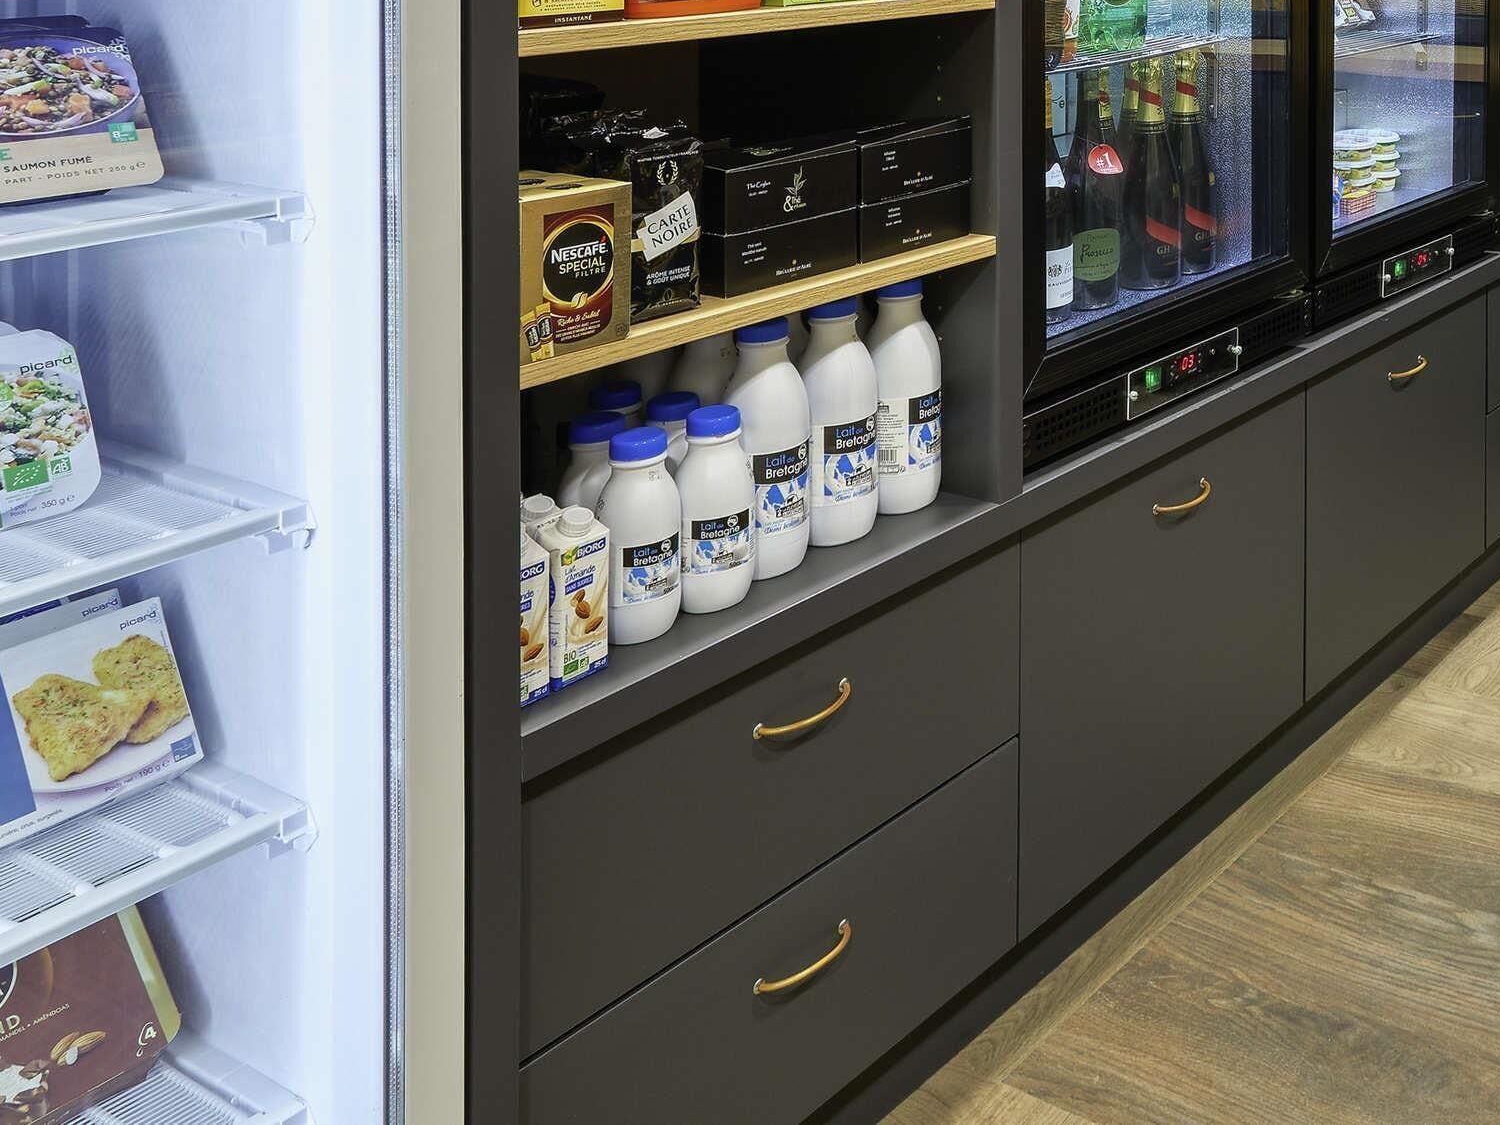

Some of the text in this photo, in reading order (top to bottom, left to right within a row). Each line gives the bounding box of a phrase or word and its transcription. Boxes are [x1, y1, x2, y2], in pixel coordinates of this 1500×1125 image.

[554, 14, 593, 24] INSTANTANÉ
[72, 43, 124, 56] picard
[3, 155, 94, 173] SAUMON FUMÉ
[1096, 152, 1115, 168] #1
[5, 176, 34, 185] PART
[47, 171, 80, 180] POIDS
[85, 167, 104, 175] NET
[647, 203, 691, 234] CARTE
[651, 217, 692, 248] NOIRE
[559, 256, 606, 275] SPECIAL
[575, 266, 606, 278] FILTRE
[646, 266, 691, 280] ARÔME INTENSE
[670, 272, 690, 281] UNIQUE
[20, 354, 73, 375] picard
[1181, 354, 1195, 371] 03
[919, 397, 933, 409] Lait
[836, 426, 855, 438] Lait
[765, 457, 786, 468] Lait
[700, 525, 740, 540] Bretagne
[701, 522, 717, 531] Lait
[633, 547, 650, 557] Lait
[633, 549, 673, 567] Bretagne
[81, 597, 118, 618] picard
[119, 610, 157, 631] picard
[563, 649, 577, 664] BIO
[145, 1026, 156, 1039] 4
